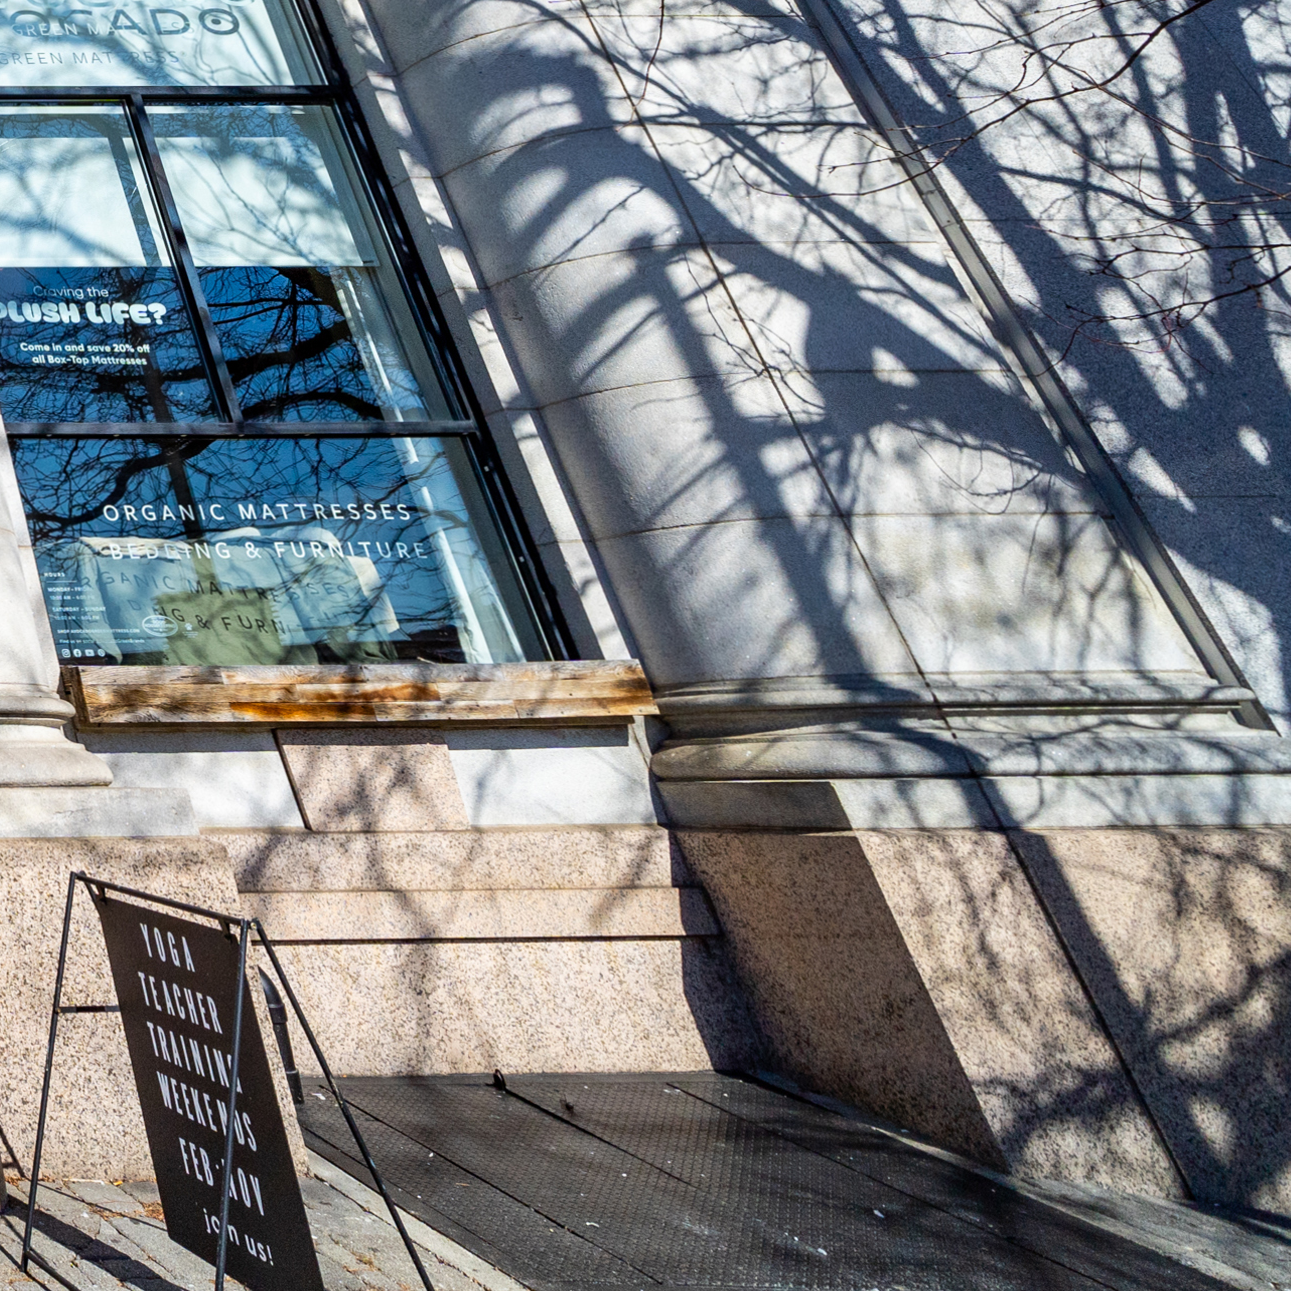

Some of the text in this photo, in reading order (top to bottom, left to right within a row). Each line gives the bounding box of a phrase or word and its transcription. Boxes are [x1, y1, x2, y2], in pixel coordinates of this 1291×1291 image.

[72, 50, 180, 64] MATRESS
[33, 285, 110, 299] Craving the
[85, 301, 167, 325] LIFE?
[19, 342, 151, 353] Come in and save 20% off
[32, 355, 147, 366] all Box-Top Mattresses
[103, 503, 411, 522] ORGANIC MATTRESSES
[245, 541, 263, 559] &
[274, 541, 429, 560] FURNITURE
[139, 922, 196, 973] YOGA
[137, 971, 224, 1035] TEACHER
[156, 1070, 258, 1152] WEEKENDS
[202, 1207, 274, 1266] jon us!
